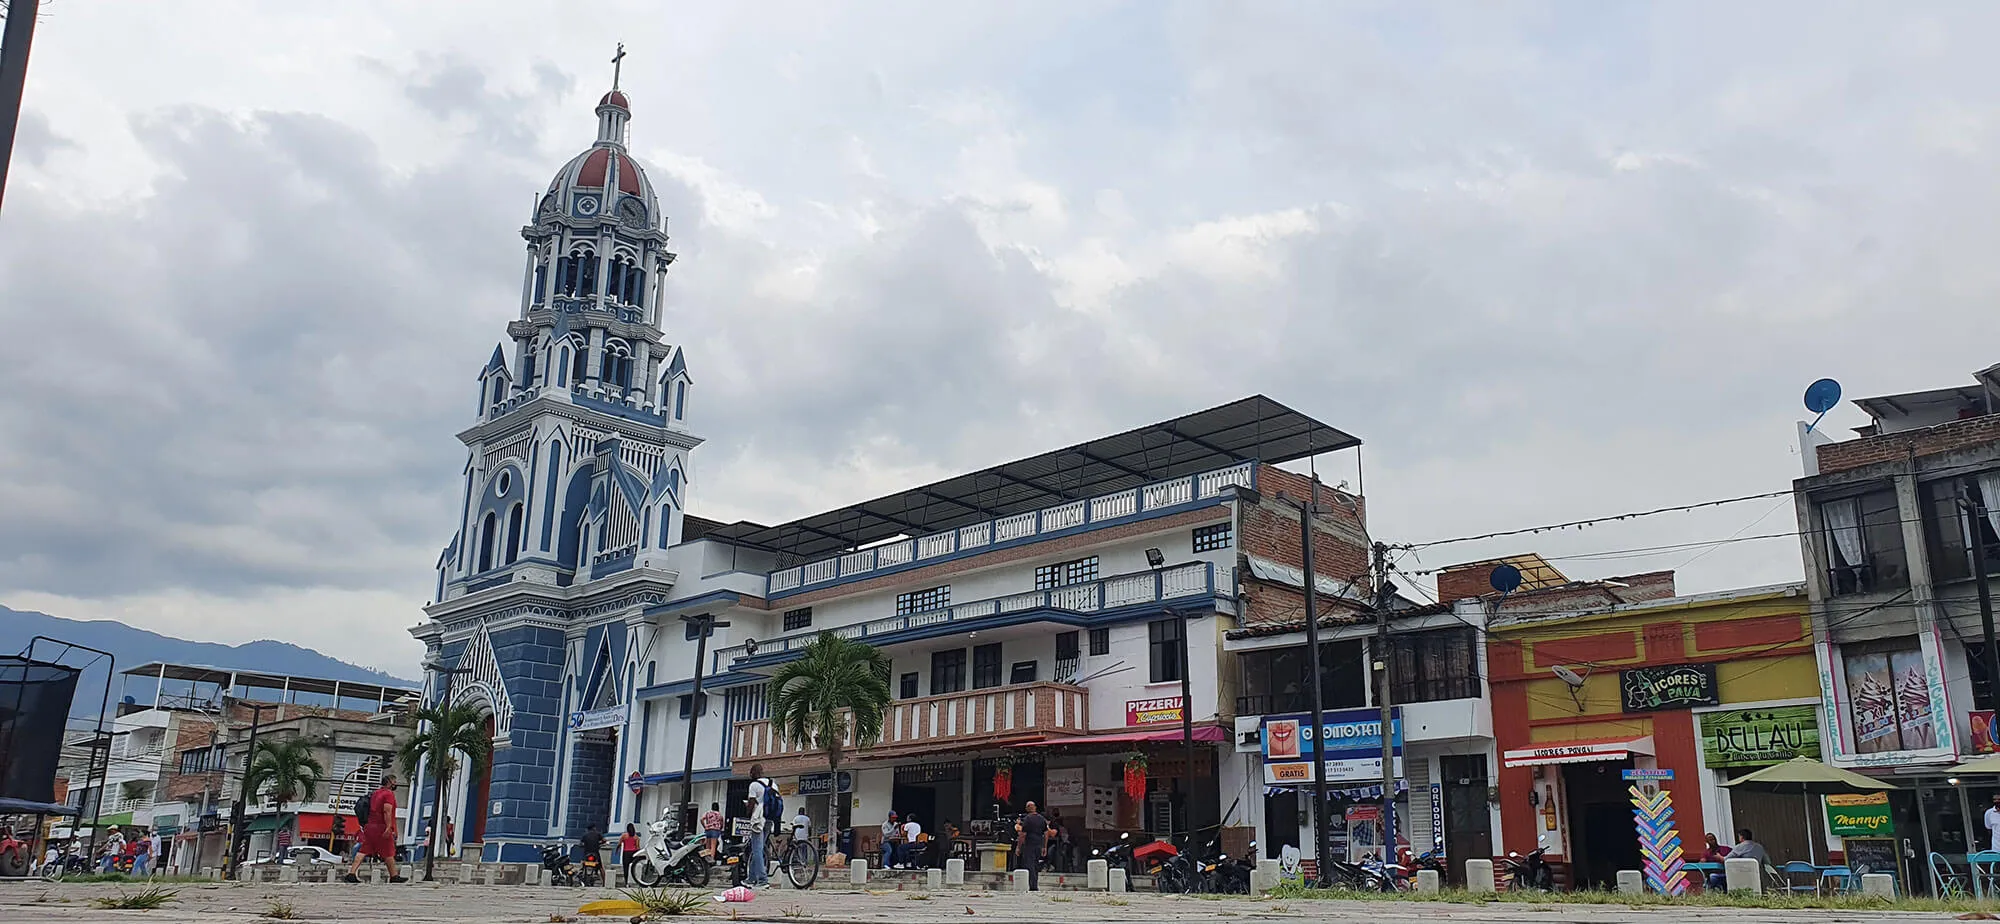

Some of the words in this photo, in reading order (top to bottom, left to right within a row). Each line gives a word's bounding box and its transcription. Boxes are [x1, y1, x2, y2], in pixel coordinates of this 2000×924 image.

[1928, 656, 1938, 688] ICE
[1650, 674, 1699, 695] LICORES
[1668, 686, 1701, 699] PAVA
[1931, 686, 1951, 748] CREAM
[1715, 722, 1803, 753] BELLAU
[1279, 769, 1304, 778] GRATIS
[800, 778, 832, 791] PRADER
[1431, 787, 1442, 850] ORTODONCI
[1834, 814, 1889, 829] Manny's
